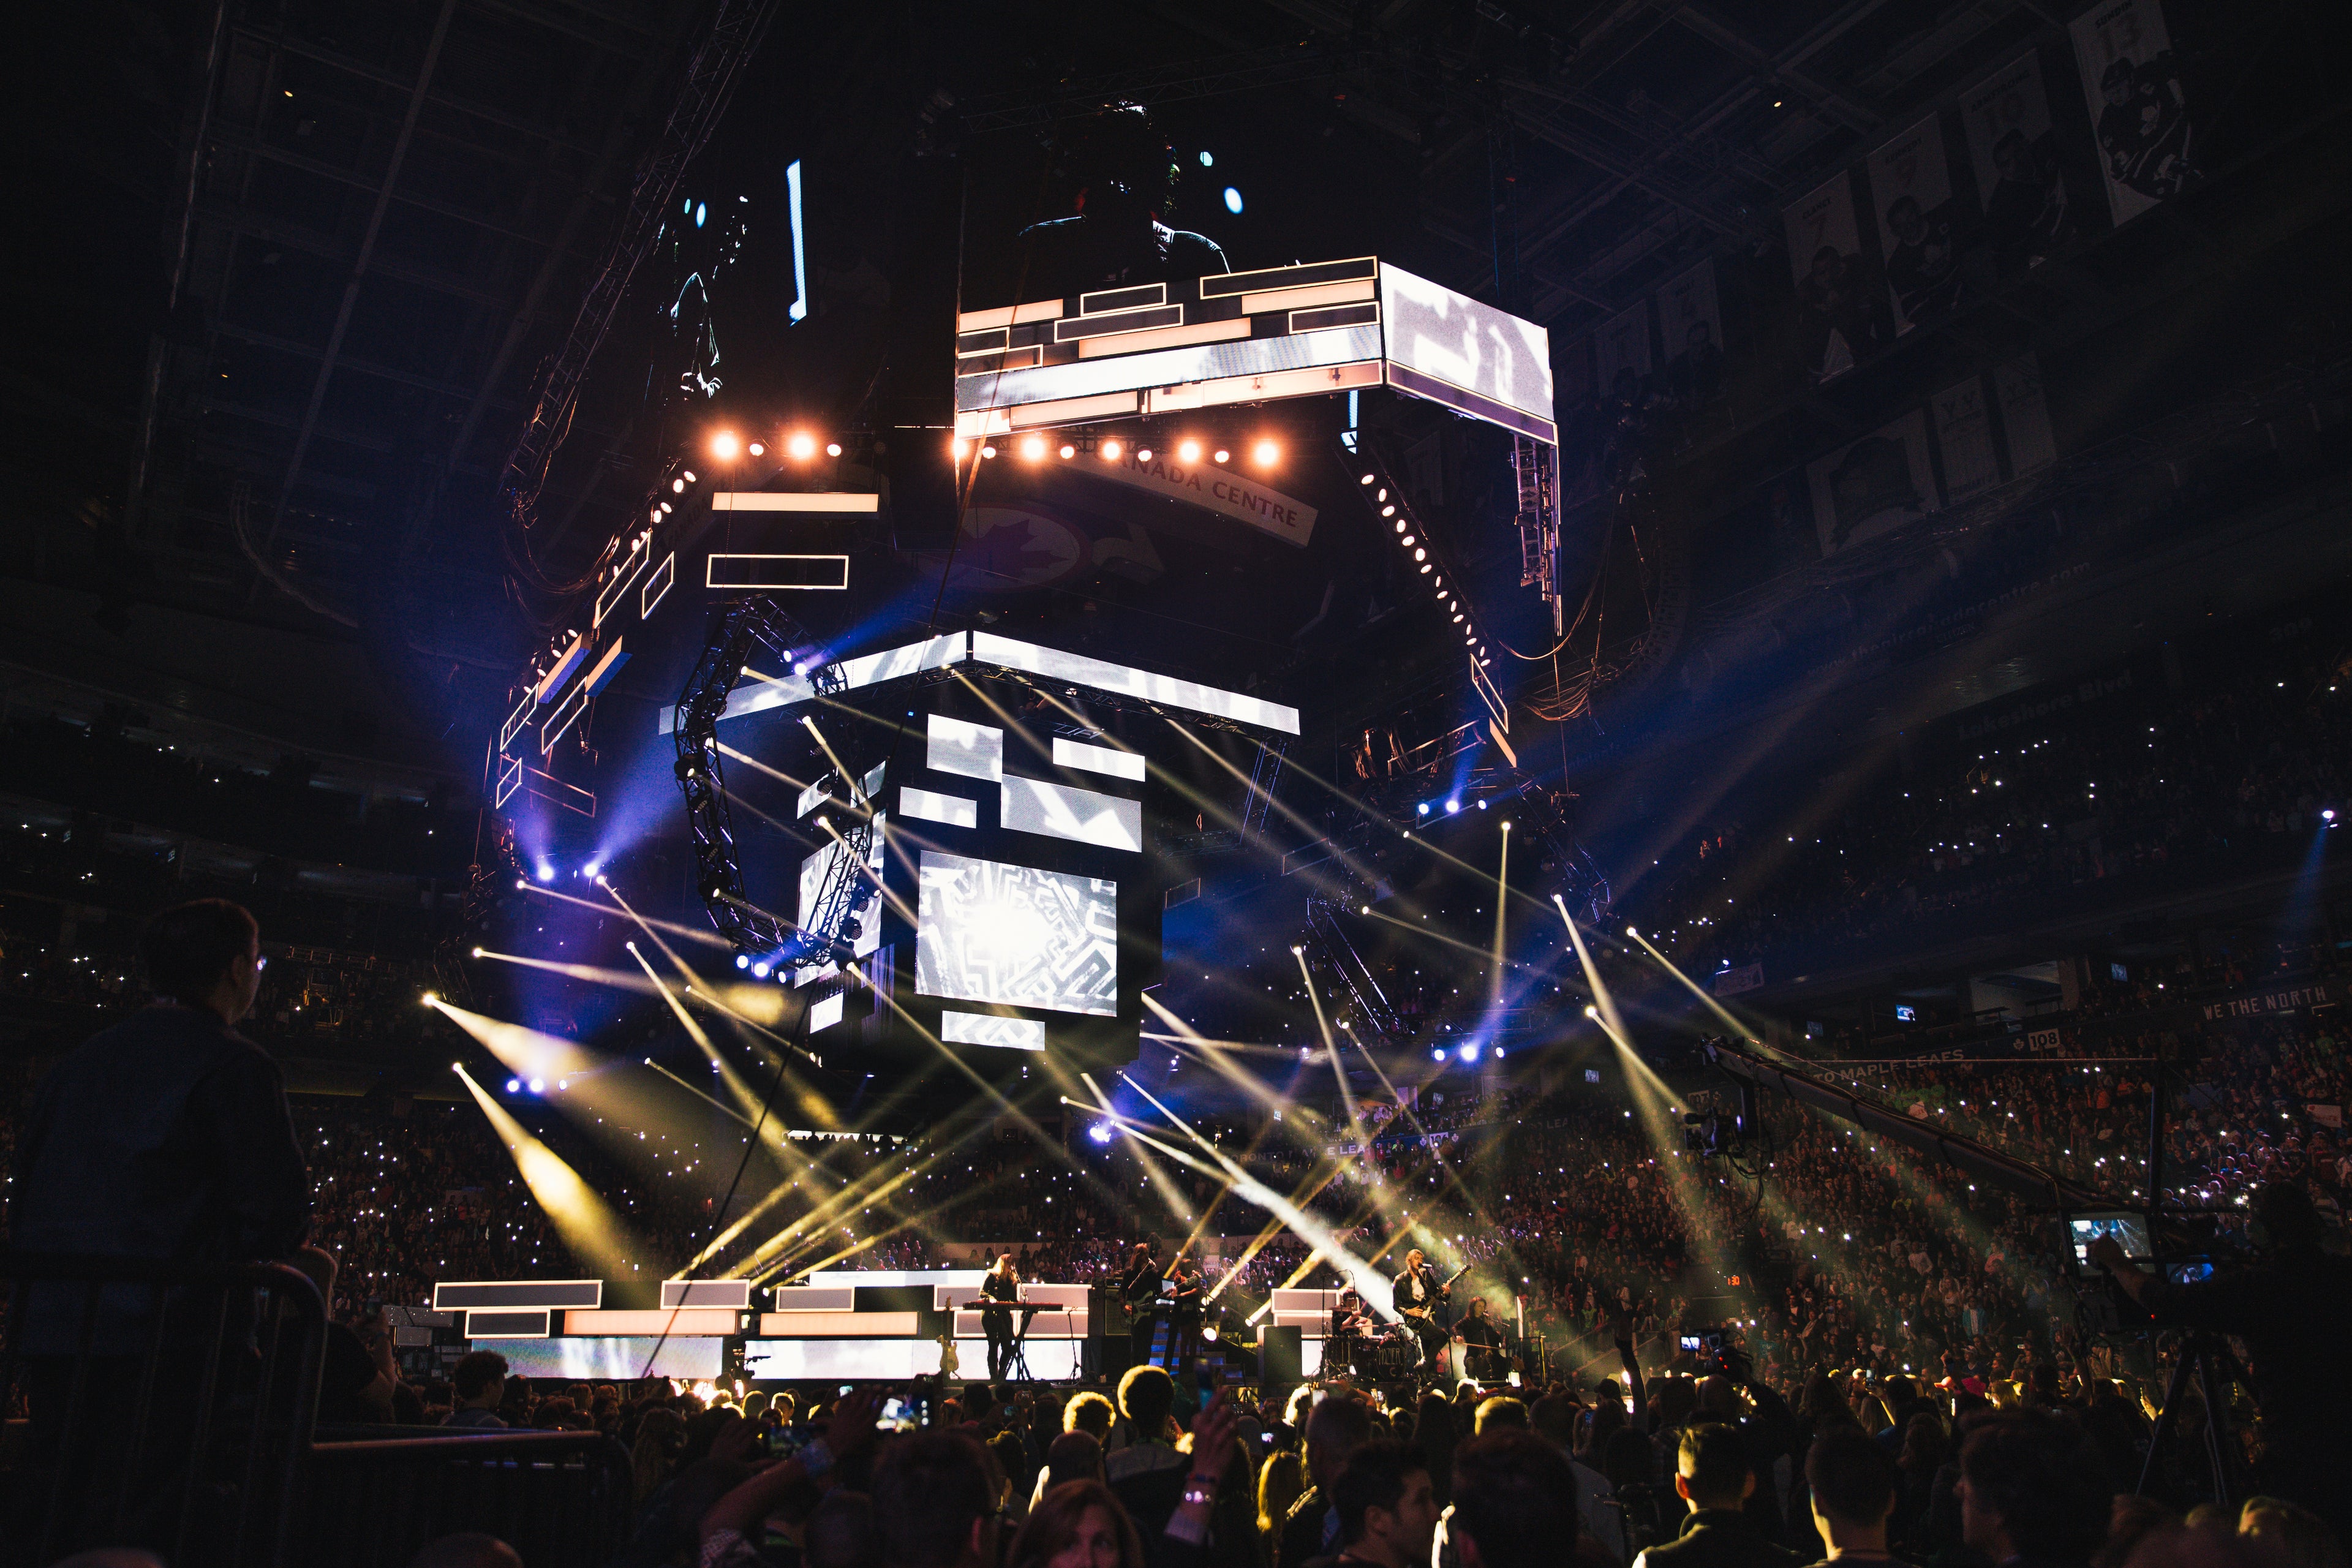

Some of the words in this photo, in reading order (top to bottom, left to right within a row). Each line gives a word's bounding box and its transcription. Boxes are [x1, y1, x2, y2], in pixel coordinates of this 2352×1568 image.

[2095, 1, 2133, 29] SUNDIN
[1212, 480, 1298, 528] CENTRE
[2078, 668, 2133, 703] Blvd
[2203, 1003, 2224, 1021] WE
[2227, 997, 2261, 1017] THE
[2266, 986, 2327, 1011] NORTH
[2030, 1031, 2058, 1048] 108
[1840, 1059, 1900, 1080] MAPLE
[1905, 1049, 1965, 1069] LEAFS
[1378, 1348, 1401, 1366] HOZIER
